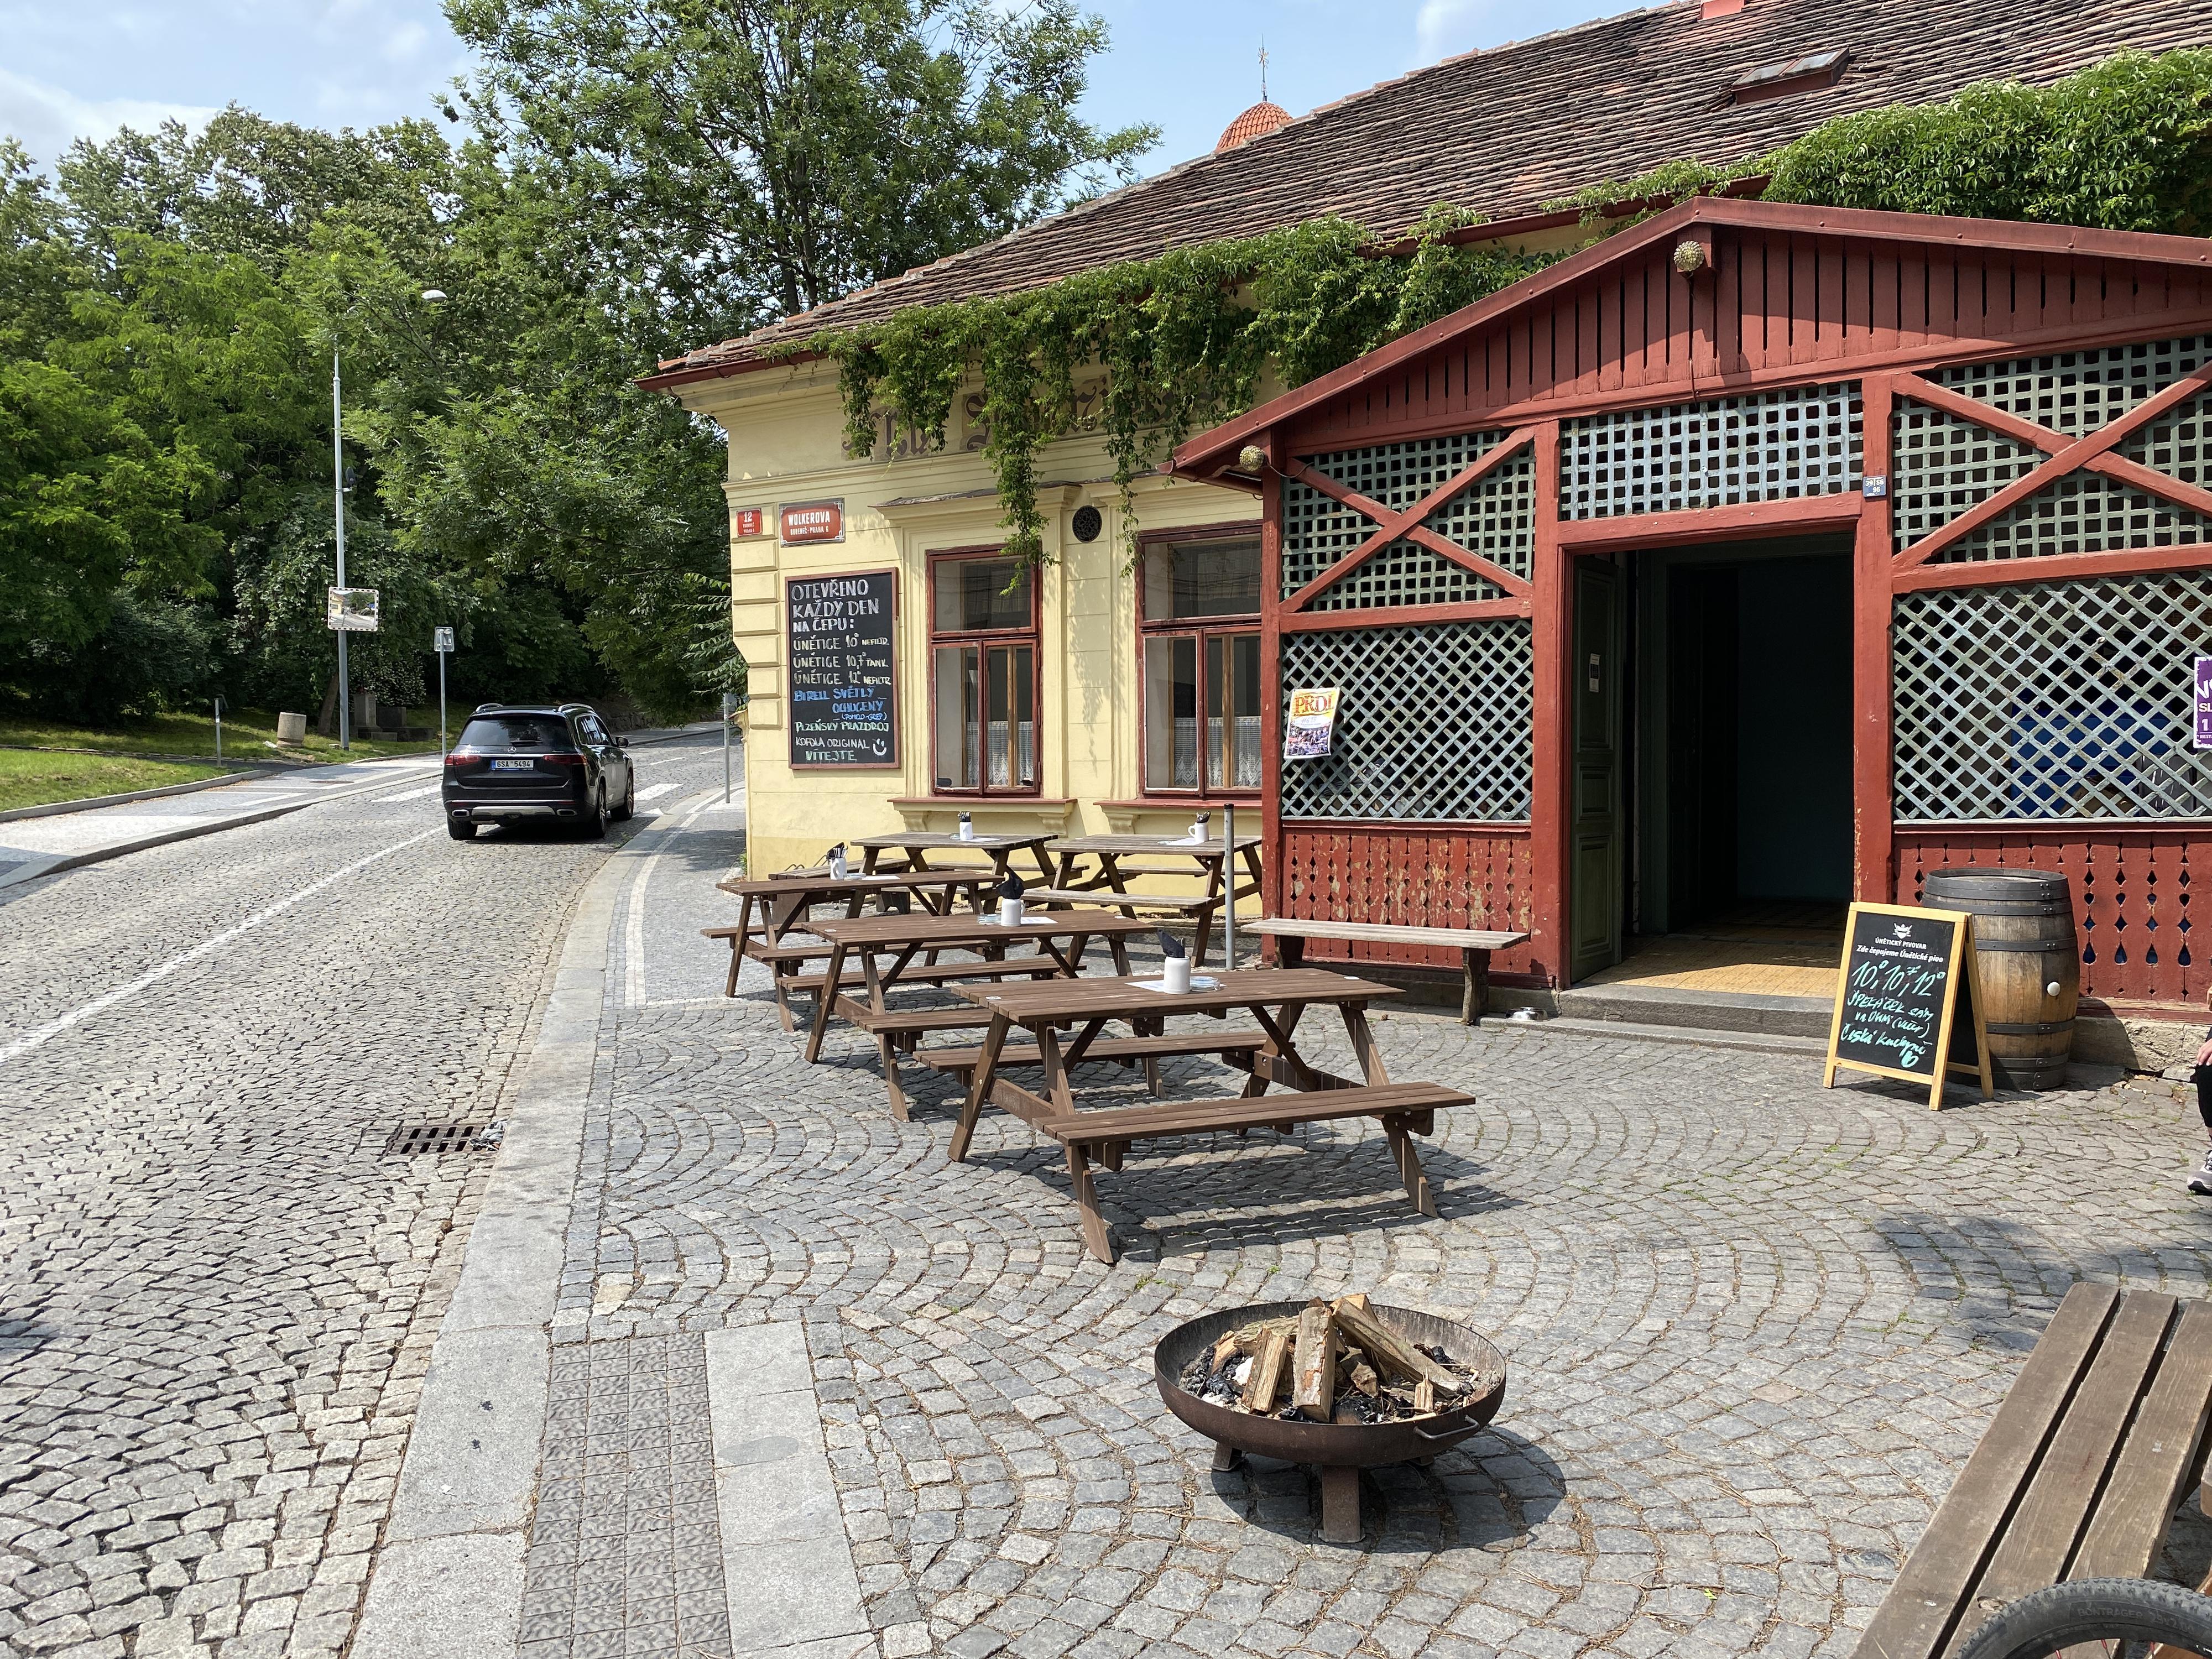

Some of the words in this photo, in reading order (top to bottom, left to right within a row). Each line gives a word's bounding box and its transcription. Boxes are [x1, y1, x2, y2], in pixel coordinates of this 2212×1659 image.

[744, 512, 753, 523] 12
[788, 511, 830, 526] WOLKEROVA
[791, 579, 869, 601] OTEVŘENO
[792, 598, 843, 618] KAŽDÝ
[846, 598, 879, 615] DEN
[793, 621, 810, 633] NA
[793, 634, 841, 650] ÚNĚTICE
[846, 633, 859, 648] 10°
[793, 651, 841, 668] ÚNĚTICE
[865, 658, 889, 667] TANK
[794, 669, 843, 684] ÚNĚTICE
[863, 676, 891, 685] NEFILTR
[833, 685, 875, 699] SVĚTLÝ
[840, 721, 889, 732] PRAZDROJ
[796, 737, 825, 747] KOFOLA
[827, 738, 870, 749] ORIGINAL
[805, 748, 857, 761] VÍTEJTE
[1875, 937, 1902, 946] ÚNĚTICKÝ
[1902, 941, 1927, 950] PIVOVAR
[1856, 945, 1869, 953] Zde
[1869, 947, 1898, 957] čepujeme
[1900, 949, 1928, 960] Únětické
[1928, 954, 1944, 963] pivo
[2077, 1608, 2143, 1619] BONTRAGER
